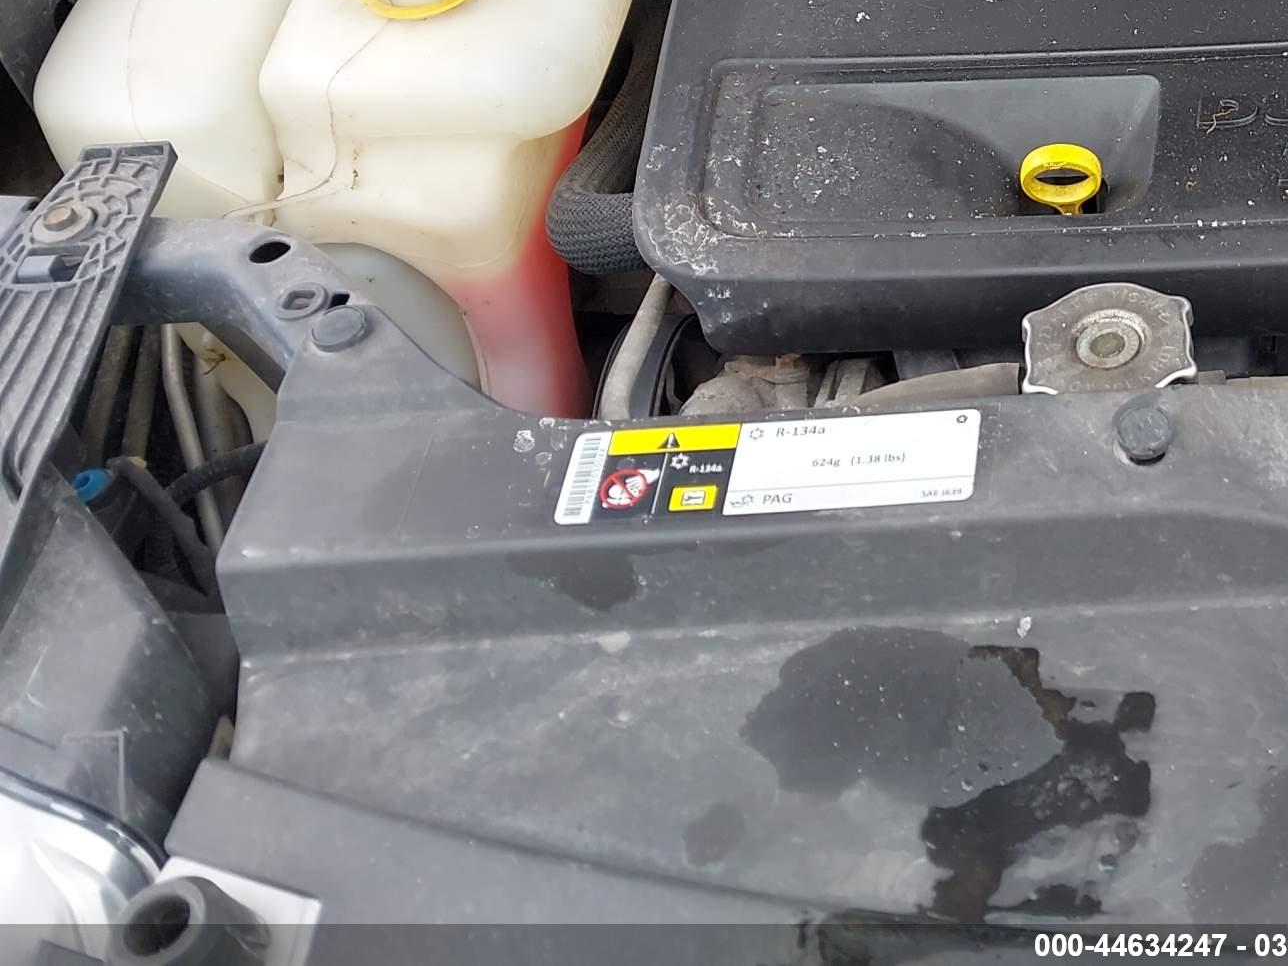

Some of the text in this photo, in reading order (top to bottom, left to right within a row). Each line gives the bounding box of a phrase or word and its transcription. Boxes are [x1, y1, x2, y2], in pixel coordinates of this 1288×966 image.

[775, 426, 826, 438] R-134a
[811, 451, 906, 468] 624g (1.38 lbs)
[688, 463, 723, 474] R-134a
[761, 492, 793, 505] PAG
[921, 488, 938, 498] SAE
